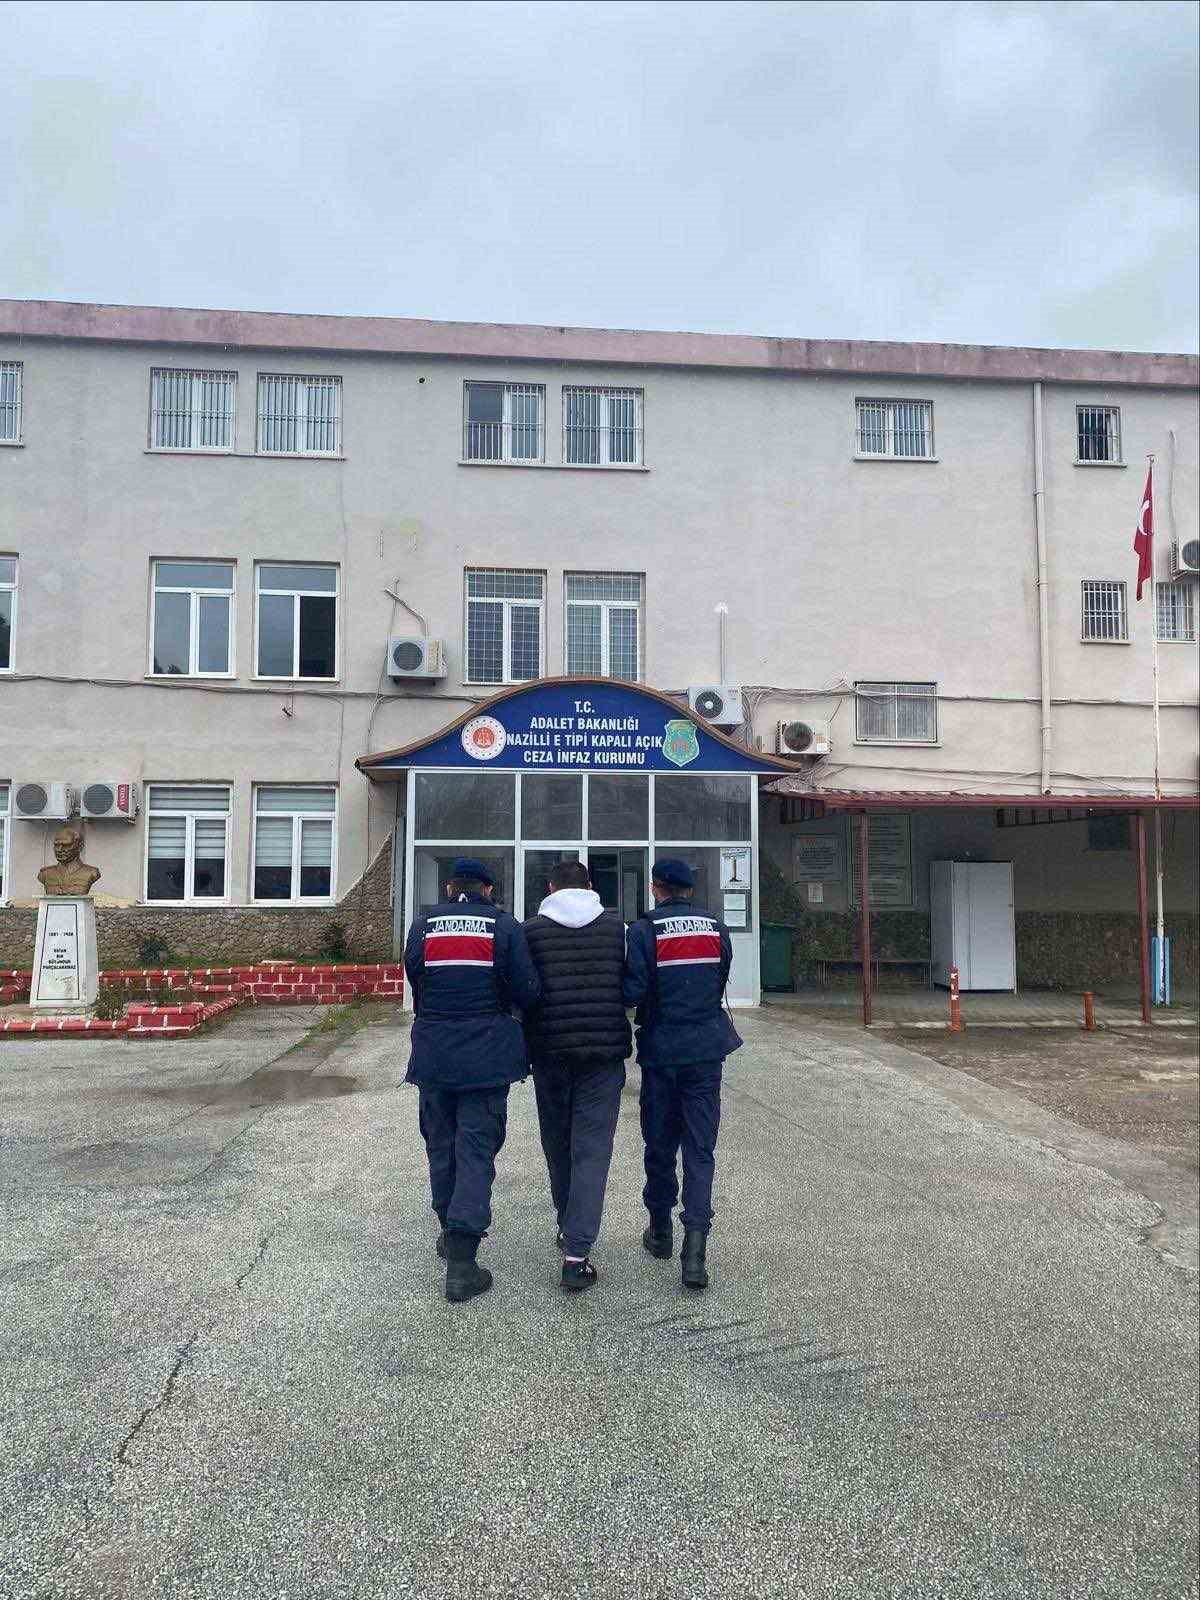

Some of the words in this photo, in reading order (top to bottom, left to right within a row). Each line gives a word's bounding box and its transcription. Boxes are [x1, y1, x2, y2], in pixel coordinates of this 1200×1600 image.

[574, 700, 595, 713] T.C.
[530, 717, 574, 729] ADALET
[577, 716, 639, 731] BAKANLIĞI
[506, 731, 550, 746] NAZİLLİ
[554, 734, 561, 746] E
[565, 731, 588, 747] TİPİ
[591, 735, 631, 748] KAPALI
[635, 736, 663, 751] AÇIK
[523, 750, 553, 763] CEZA
[557, 748, 590, 764] İNFAZ
[594, 752, 645, 764] KURUMU
[432, 919, 487, 933] JANDARMA
[663, 919, 714, 934] JANDARMA
